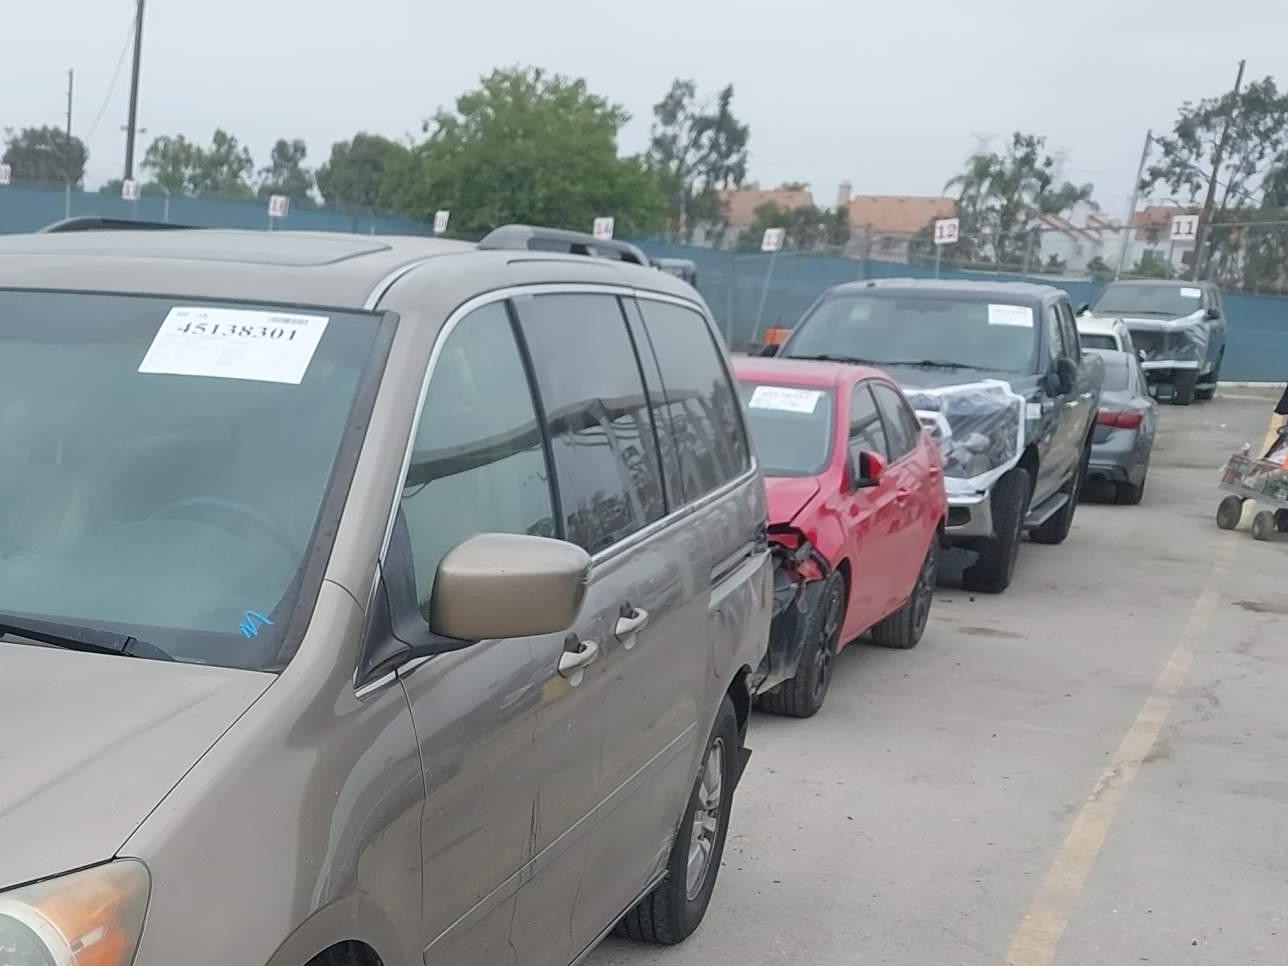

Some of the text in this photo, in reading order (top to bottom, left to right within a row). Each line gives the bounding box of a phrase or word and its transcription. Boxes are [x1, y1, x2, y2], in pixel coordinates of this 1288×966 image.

[938, 223, 957, 240] 12
[1172, 220, 1194, 236] 11
[177, 321, 298, 341] 45138301
